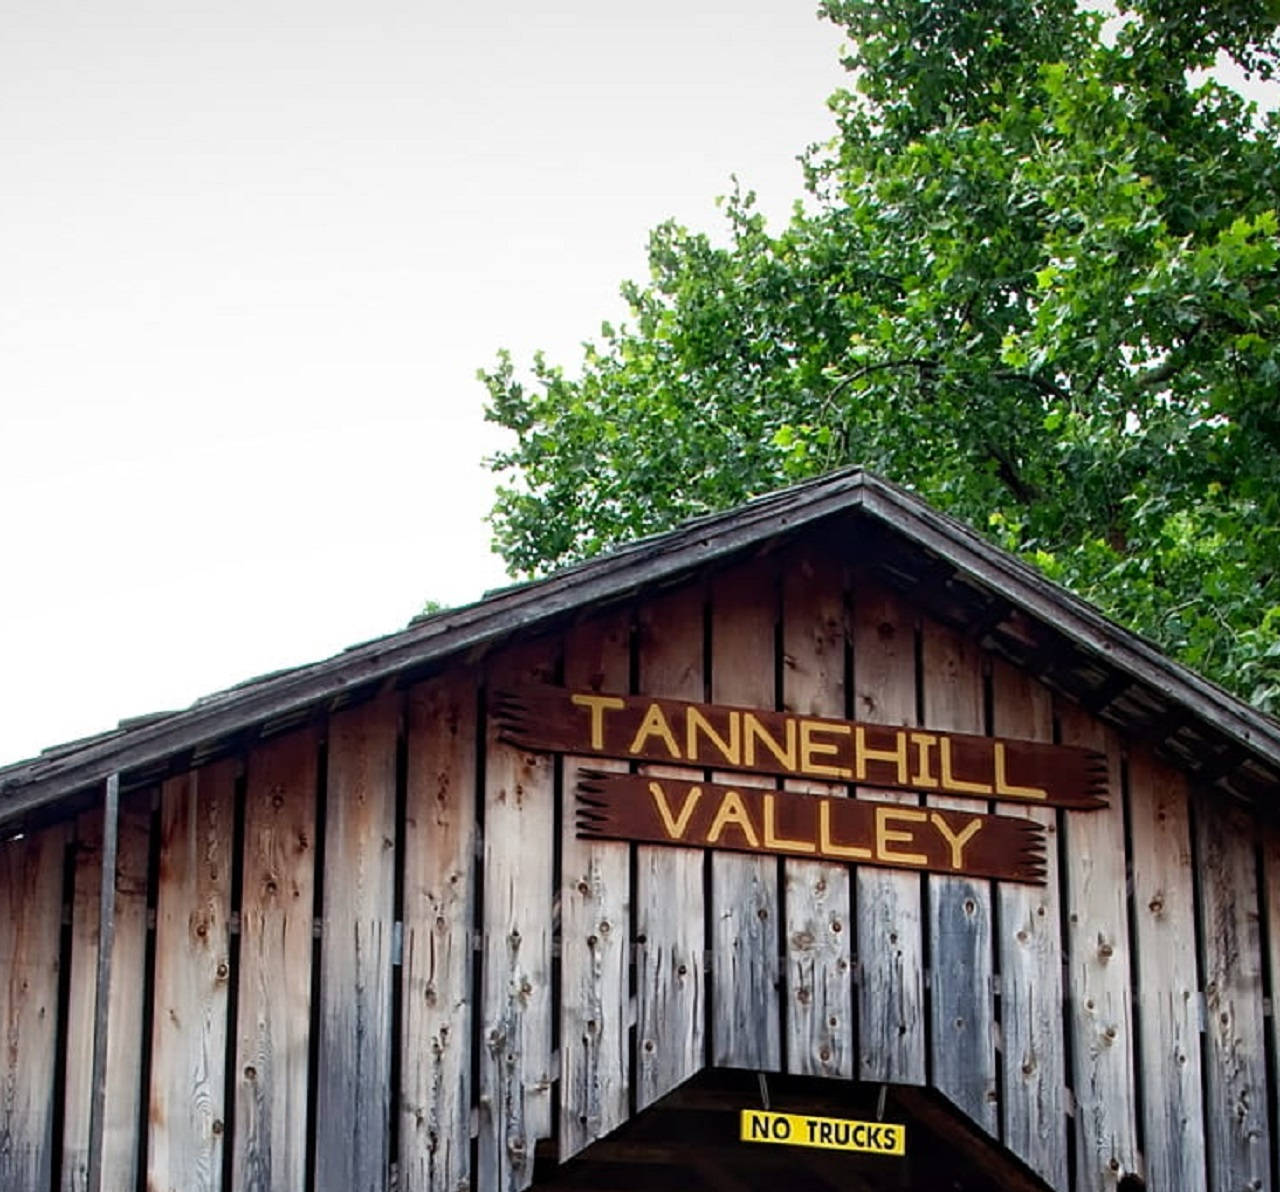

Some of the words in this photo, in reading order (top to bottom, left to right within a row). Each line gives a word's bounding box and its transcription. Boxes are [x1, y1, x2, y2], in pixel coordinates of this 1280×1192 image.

[571, 694, 1047, 799] TANNEHILL
[649, 782, 982, 869] VALLEY
[752, 1115, 790, 1139] NO
[807, 1121, 896, 1149] TRUCKS
